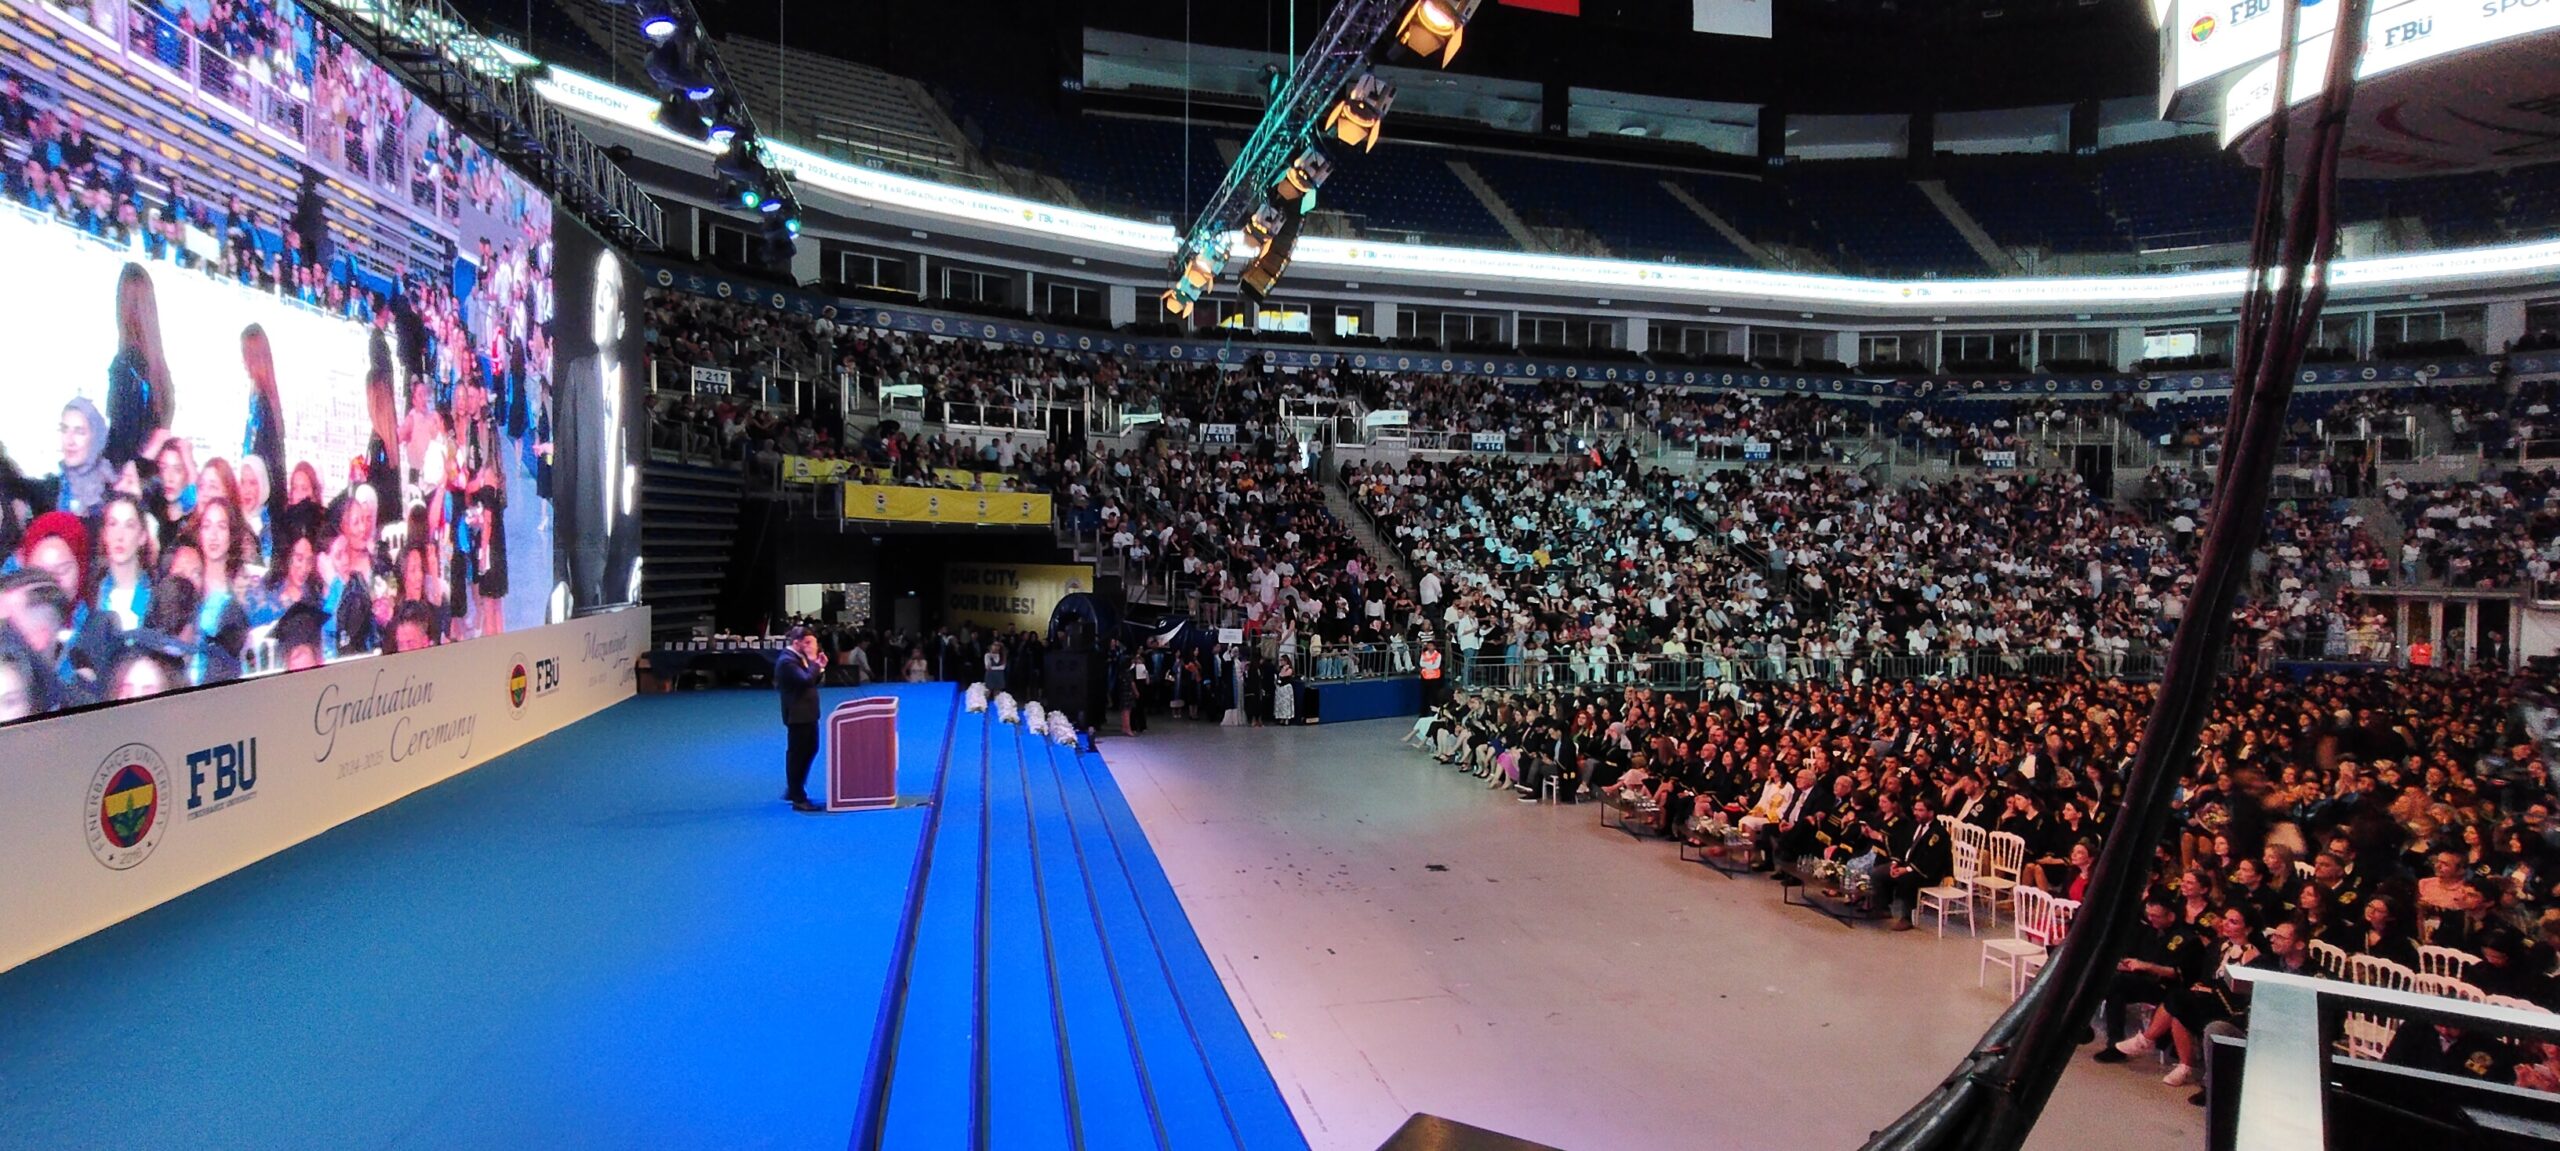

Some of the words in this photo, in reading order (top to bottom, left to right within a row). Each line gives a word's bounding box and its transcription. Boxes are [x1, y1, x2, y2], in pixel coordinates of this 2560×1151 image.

[496, 32, 520, 48] 418
[2385, 16, 2433, 47] FBÜ
[561, 83, 629, 112] CEREMONY
[808, 163, 829, 177] 2025
[830, 171, 876, 189] ACADEMIC
[878, 184, 902, 194] YEAR
[866, 159, 884, 169] 417
[705, 371, 727, 383] 217
[706, 383, 727, 395] 117
[951, 568, 979, 585] OUR
[983, 569, 1019, 590] CITY,
[951, 593, 979, 611] OUR
[983, 595, 1036, 615] RULES!
[536, 656, 560, 692] FBÜ
[314, 668, 433, 763] Graduation
[390, 713, 477, 763] Ceremony
[187, 737, 257, 810] FBU
[87, 748, 131, 852] FENERBAHÇE
